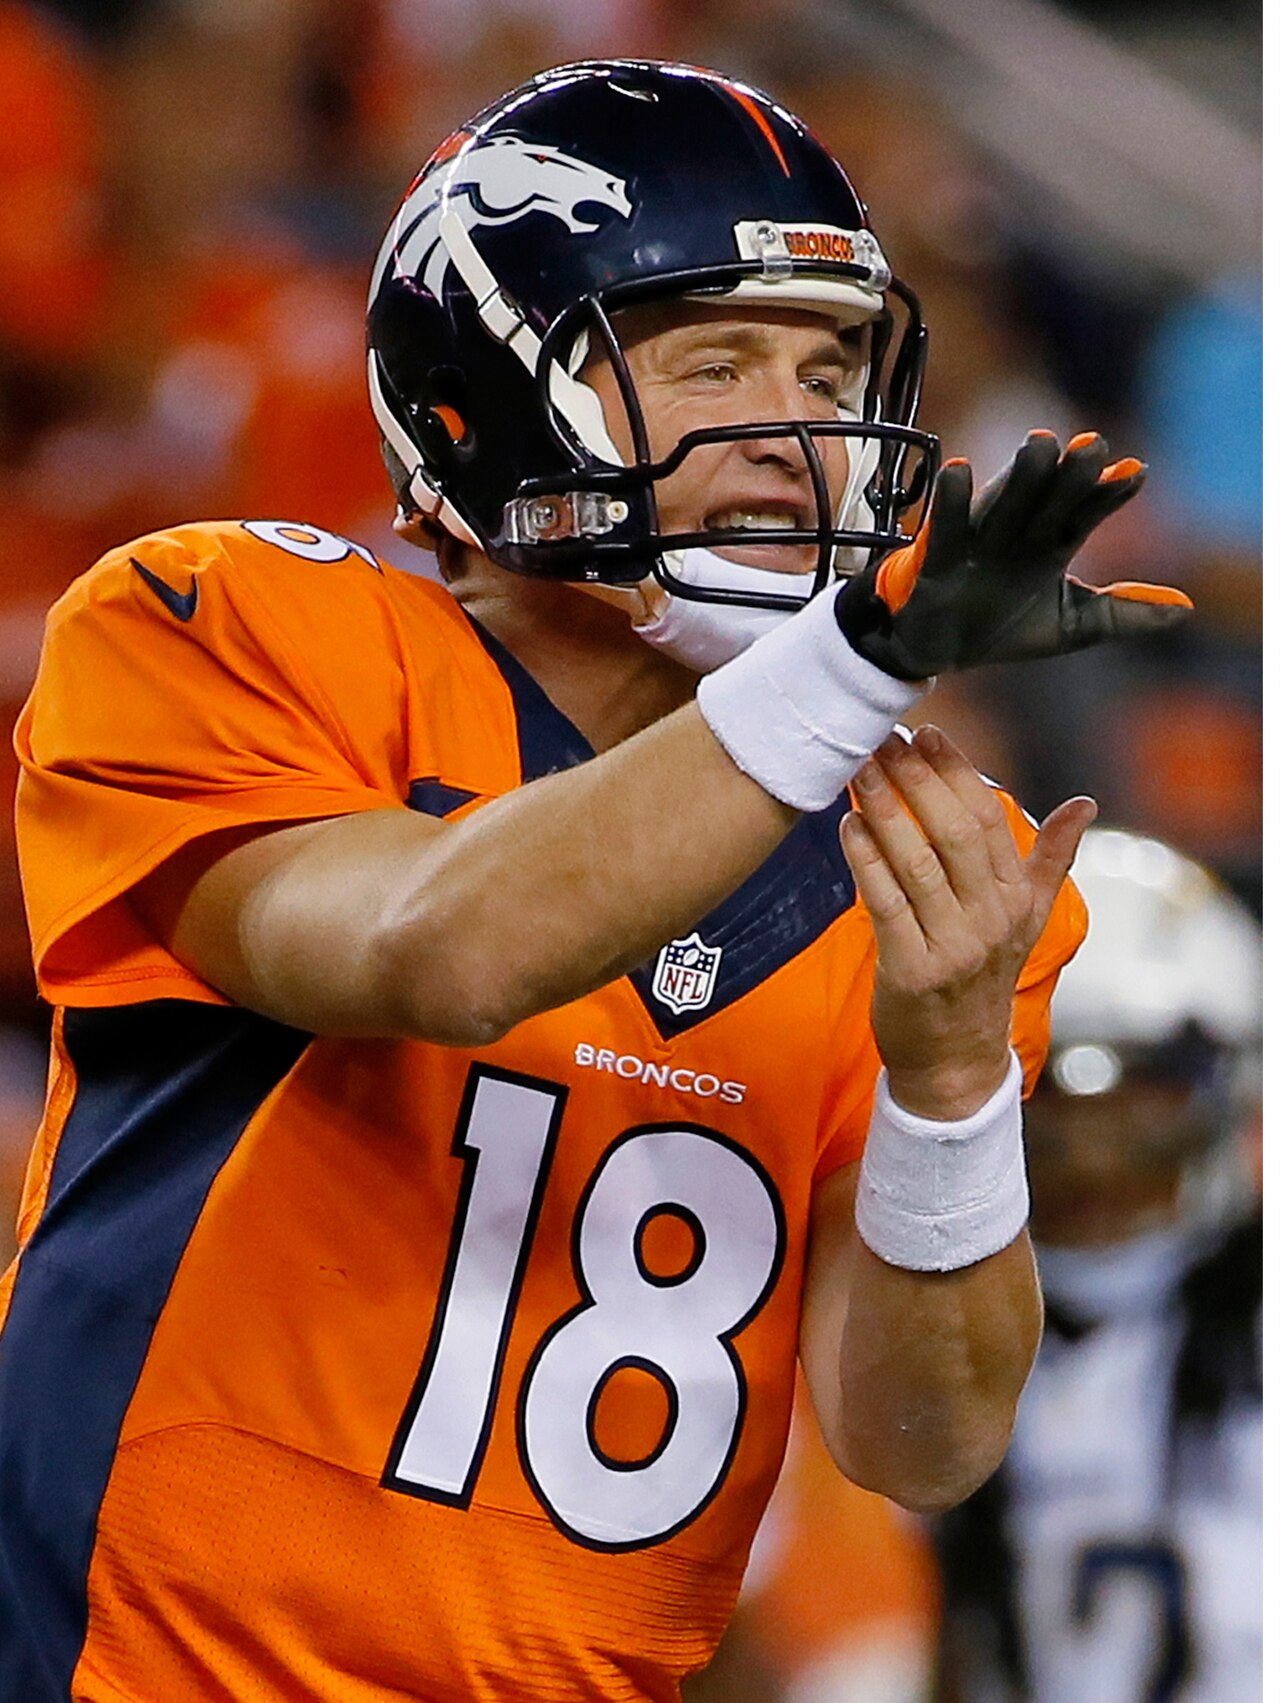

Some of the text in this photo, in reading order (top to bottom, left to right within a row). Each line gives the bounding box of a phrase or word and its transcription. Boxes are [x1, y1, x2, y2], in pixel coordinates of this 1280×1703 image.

[662, 966, 703, 1001] NFL
[574, 1042, 748, 1104] BRONCOS
[380, 1060, 788, 1554] 18
